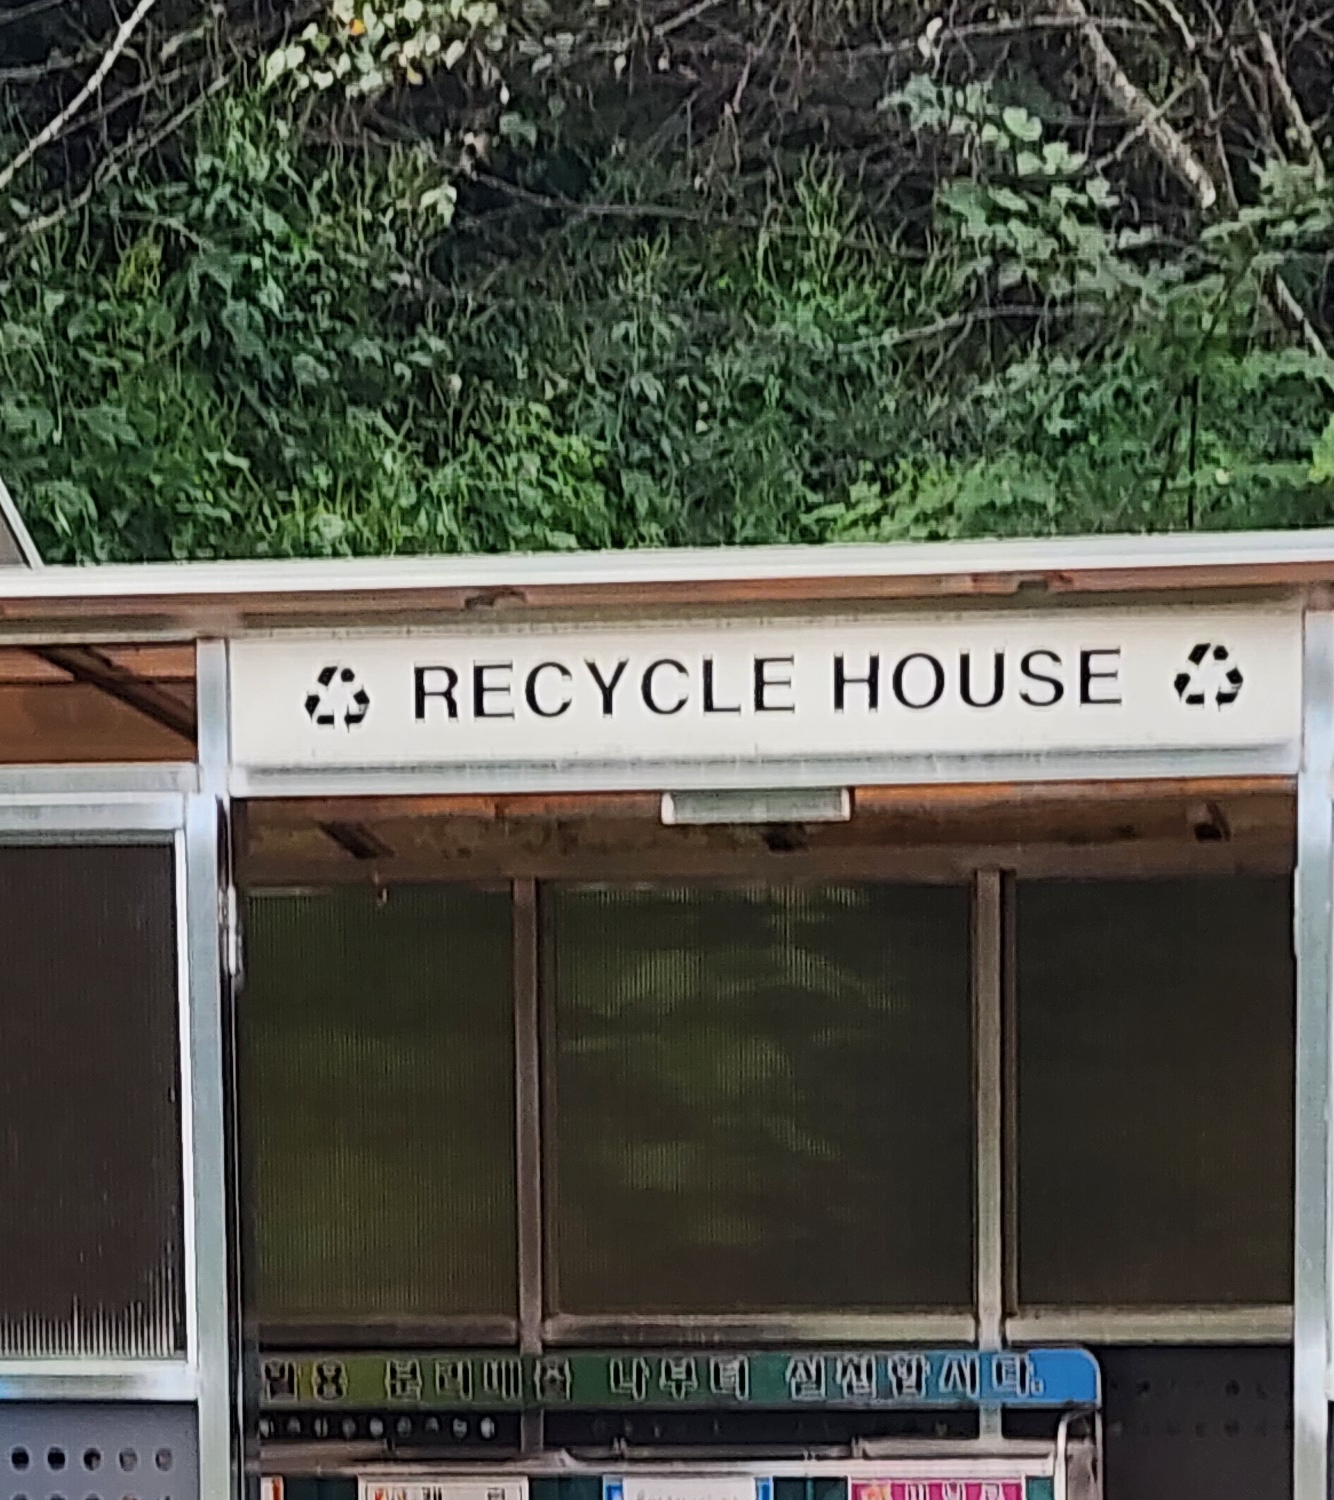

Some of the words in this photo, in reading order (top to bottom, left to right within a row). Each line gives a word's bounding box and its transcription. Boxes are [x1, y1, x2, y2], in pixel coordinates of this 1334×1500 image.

[412, 653, 796, 723] RECYCLE
[830, 646, 1123, 715] HOUSE
[384, 1357, 572, 1402] 분리배출
[609, 1355, 750, 1401] 나부터
